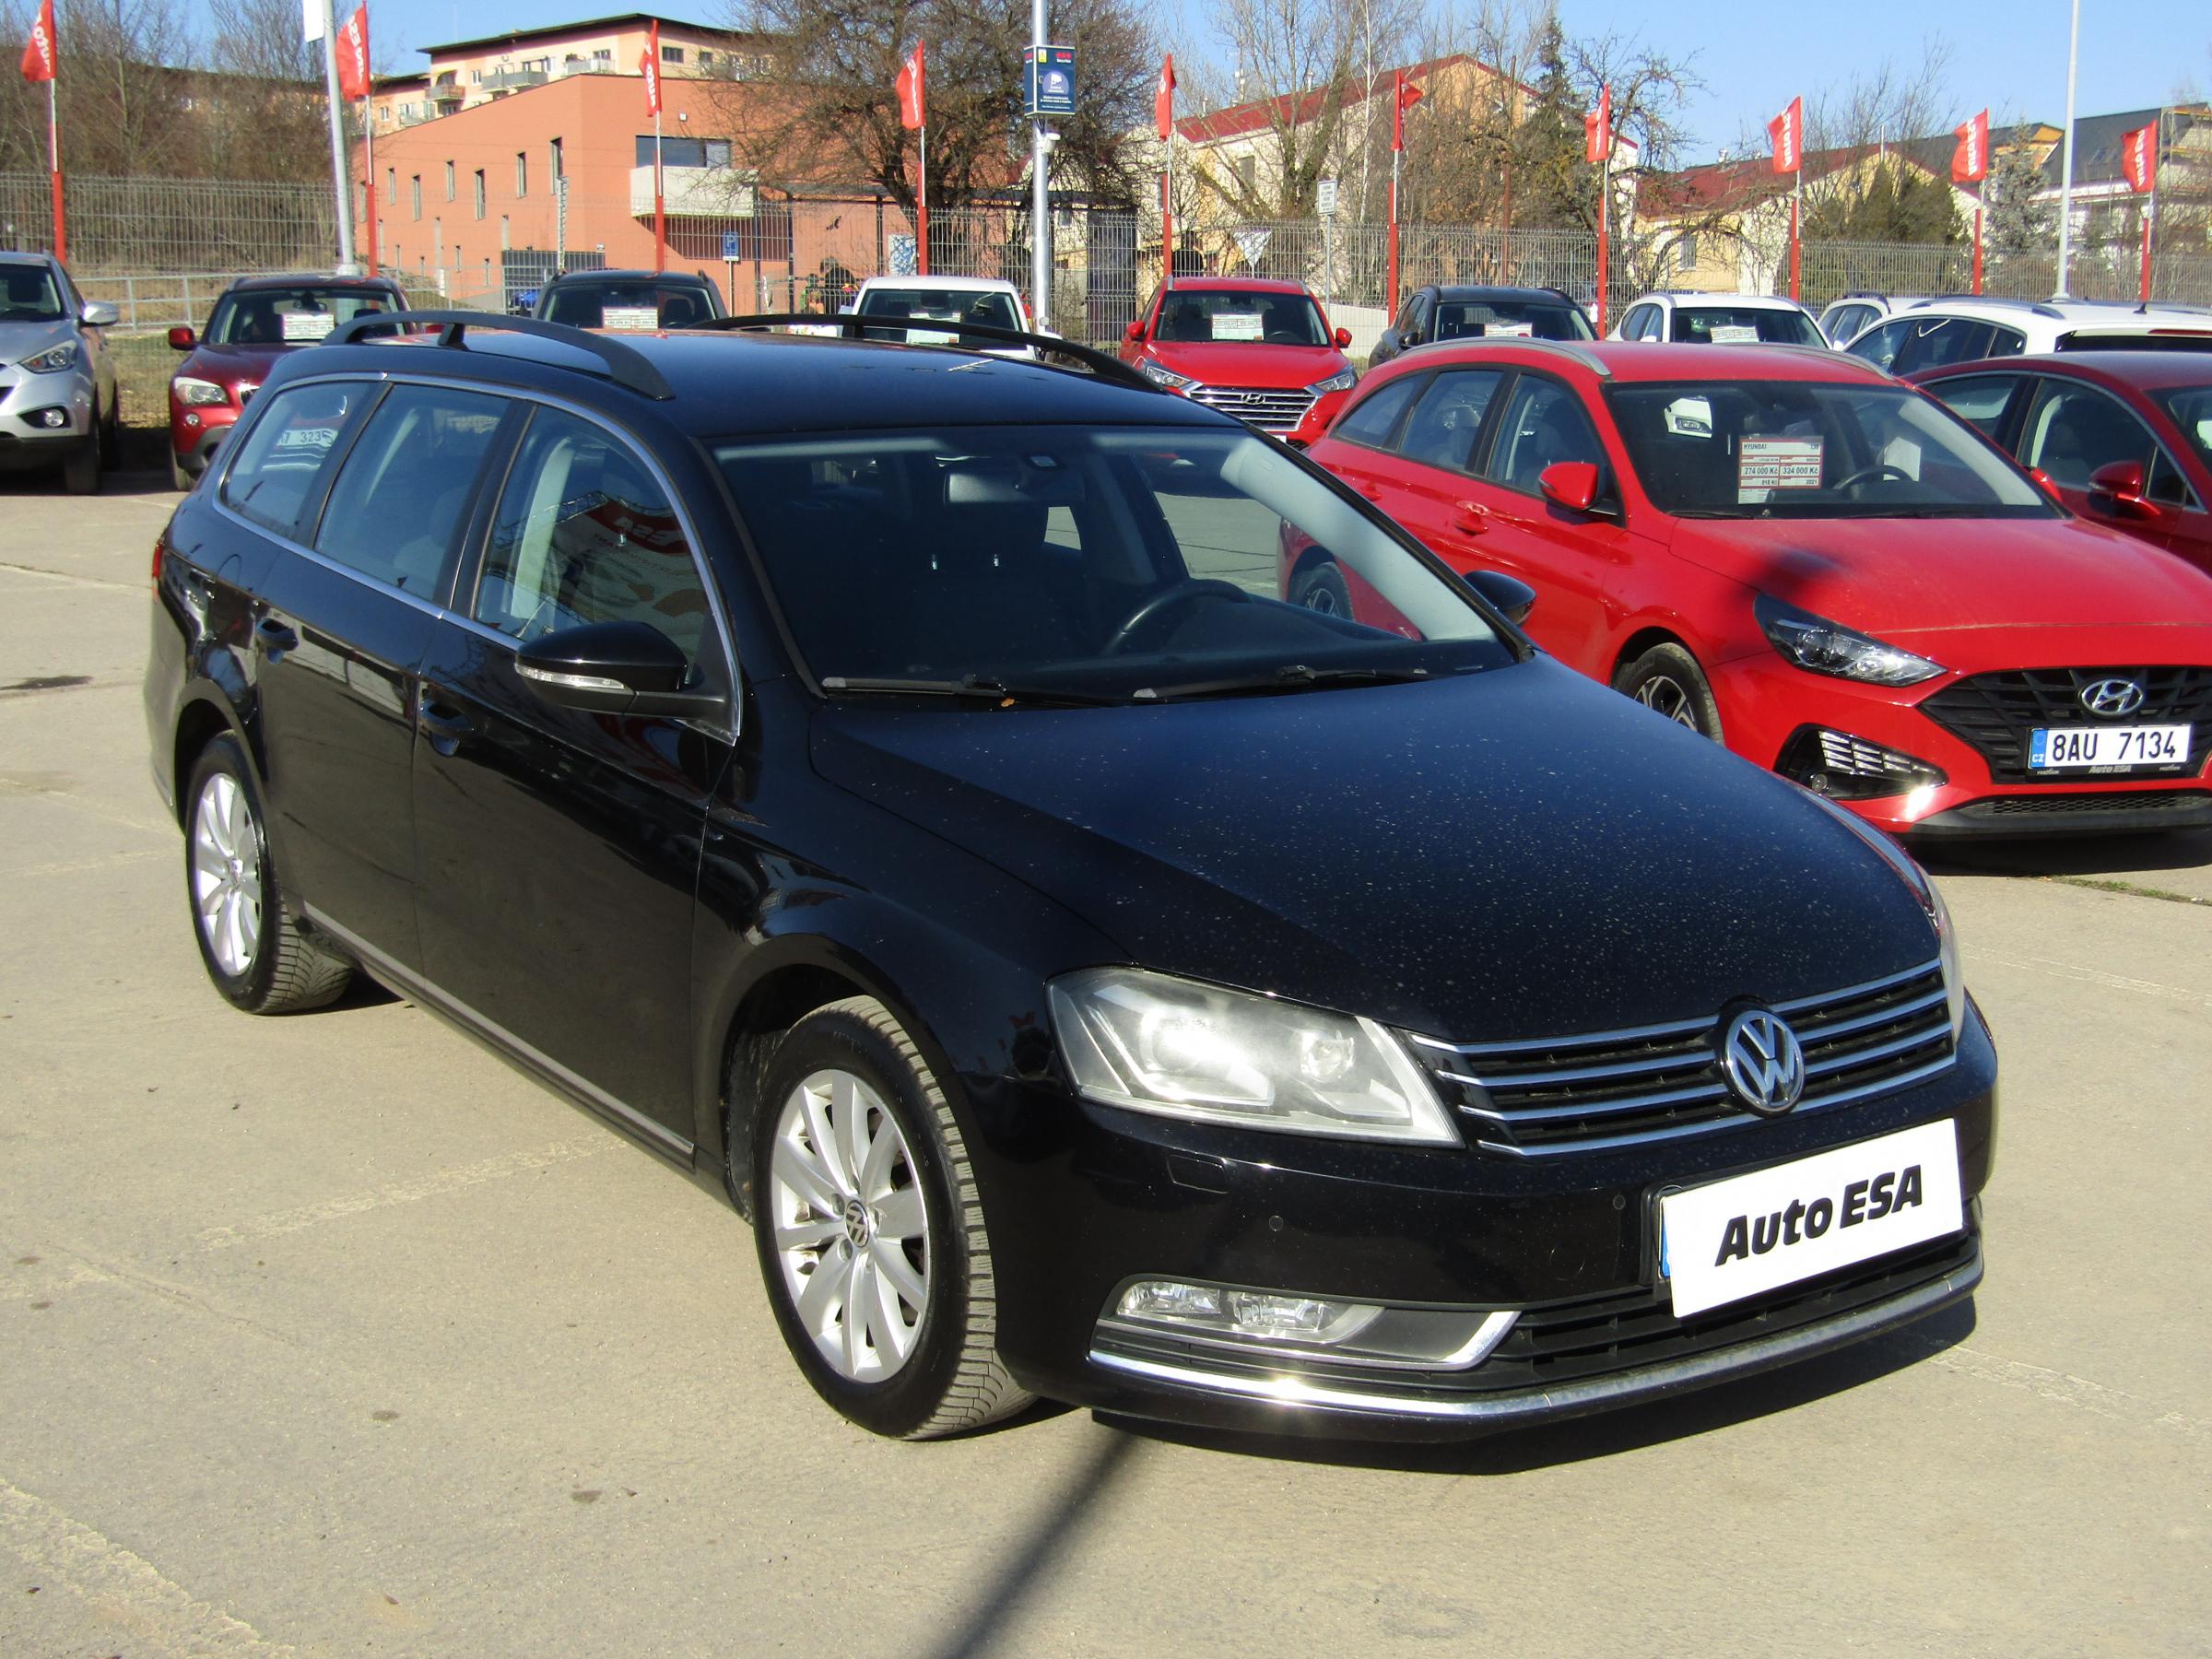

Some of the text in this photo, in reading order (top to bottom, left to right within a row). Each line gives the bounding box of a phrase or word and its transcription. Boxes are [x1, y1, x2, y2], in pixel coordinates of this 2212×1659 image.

[2031, 753, 2044, 763] CZ
[2052, 731, 2176, 762] 8AU 7134
[1714, 1164, 1924, 1267] Auto ESA
